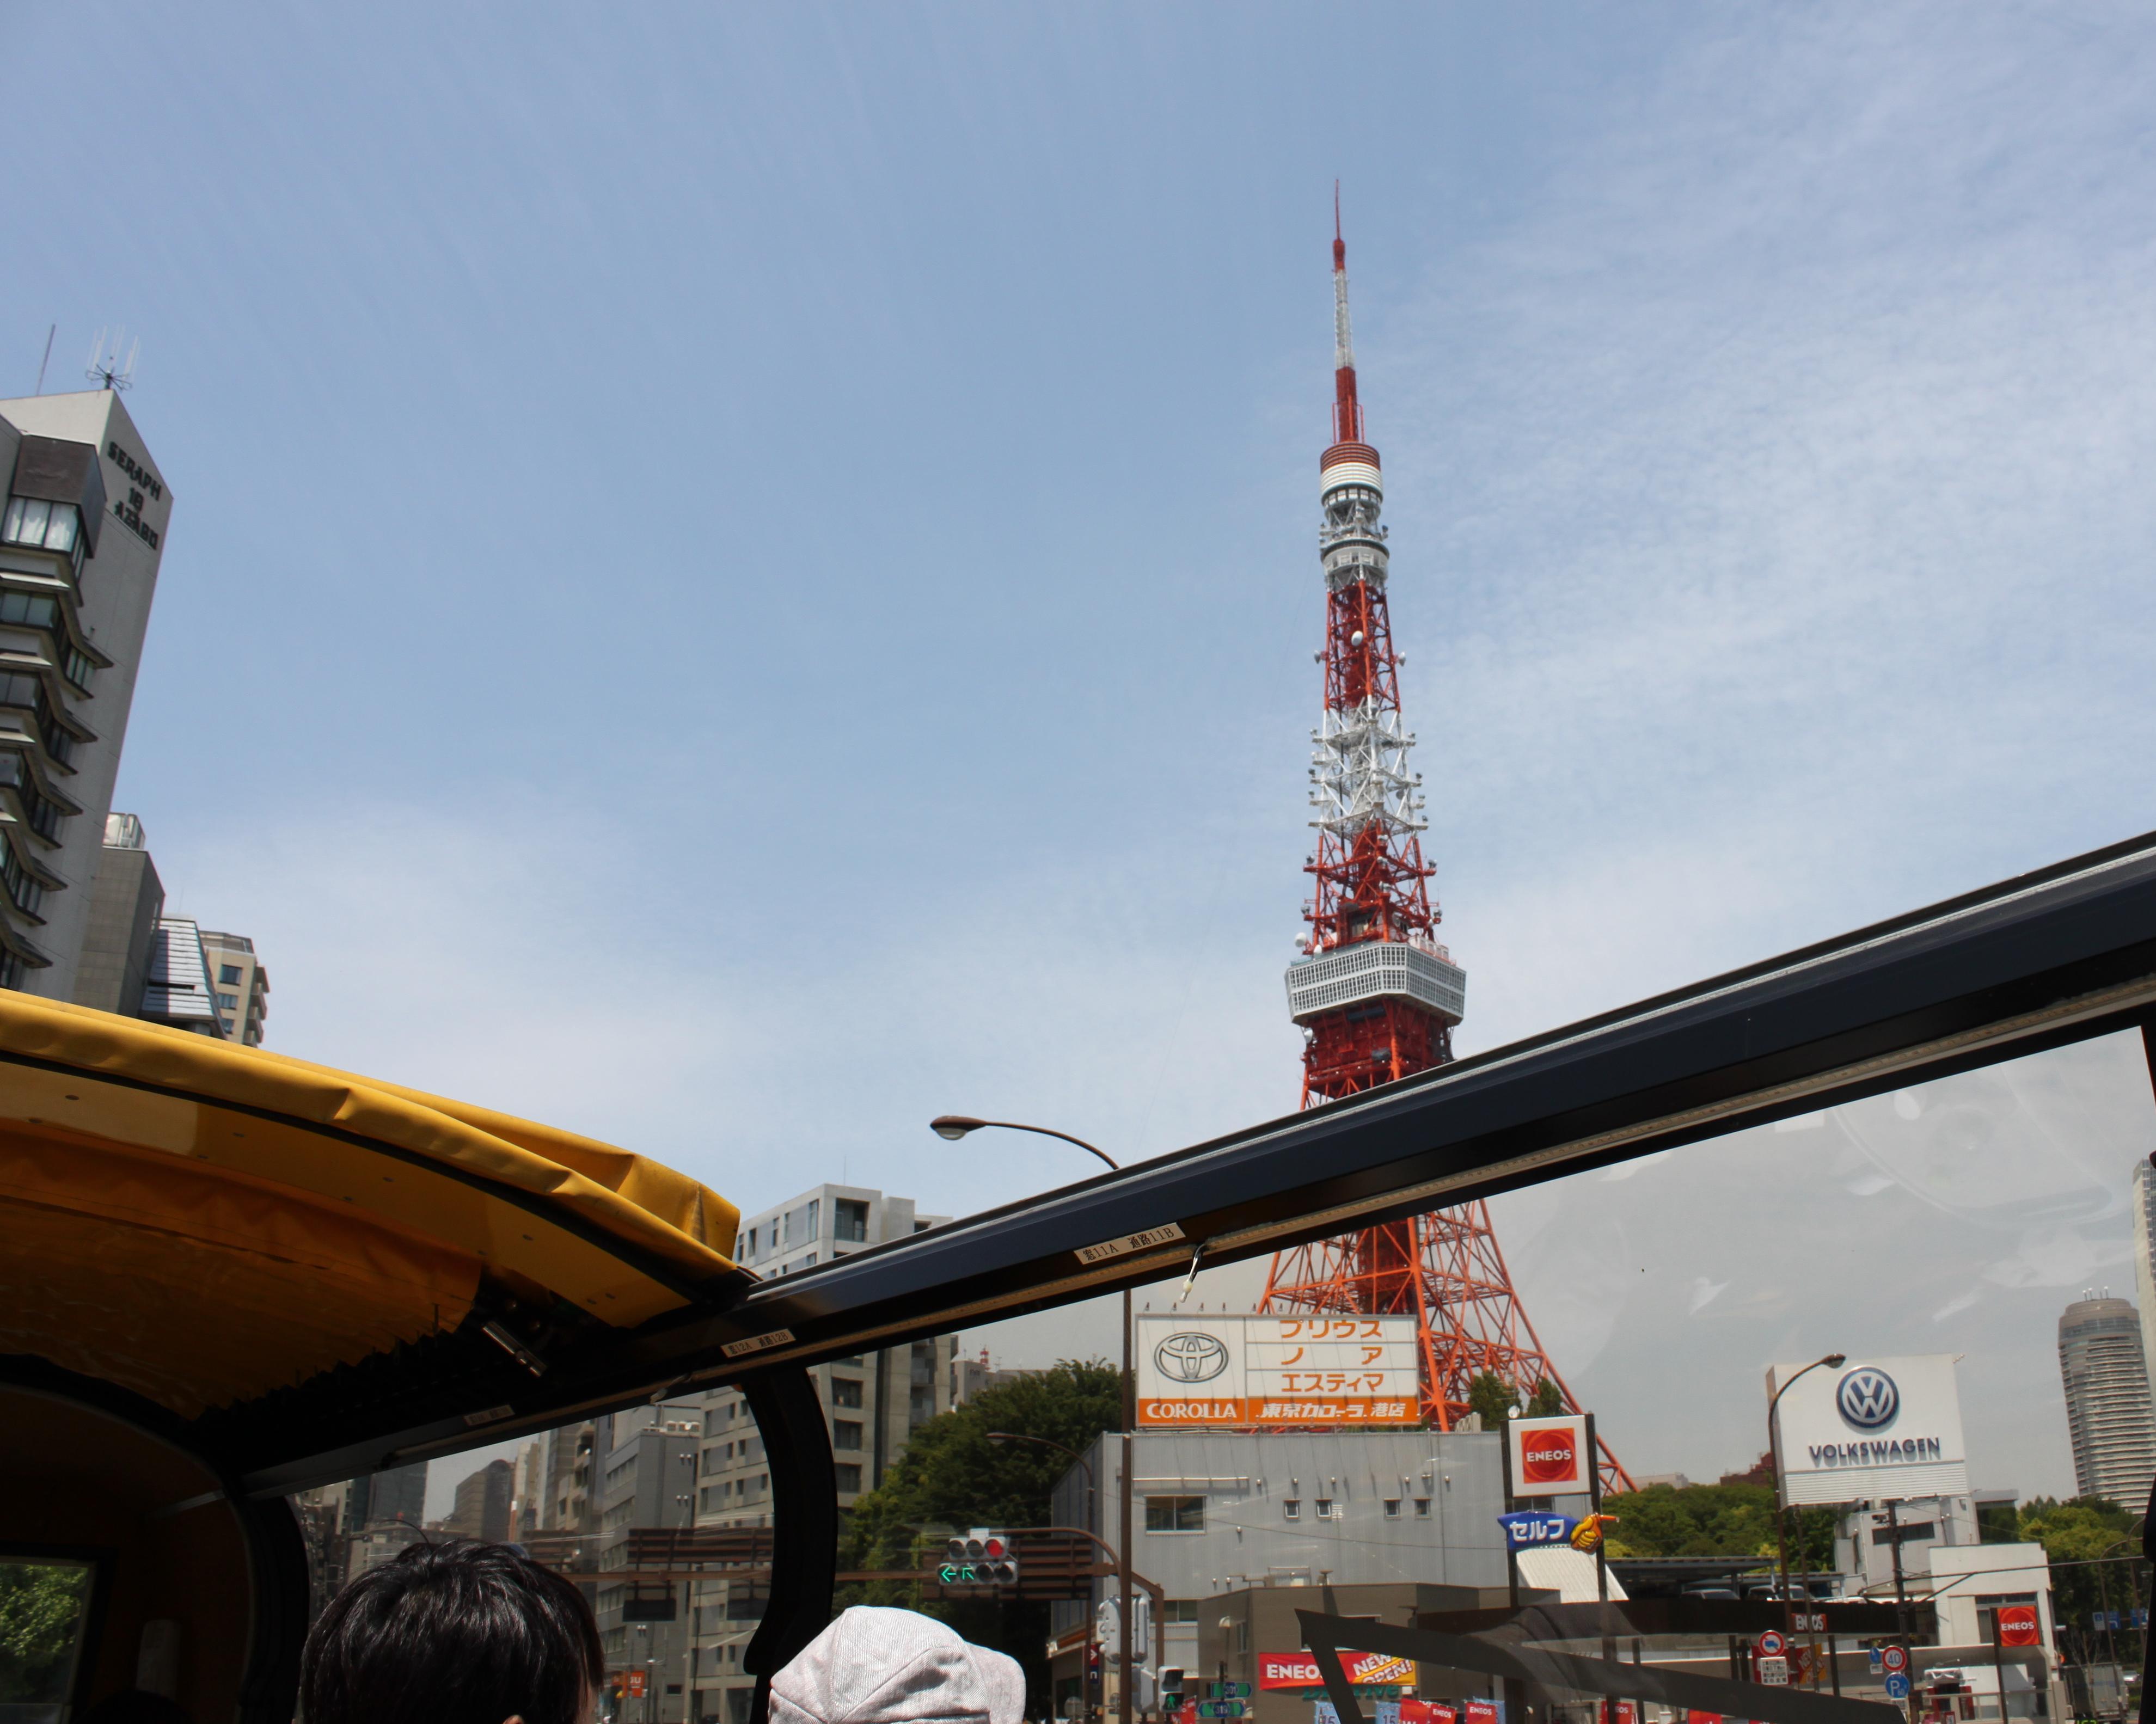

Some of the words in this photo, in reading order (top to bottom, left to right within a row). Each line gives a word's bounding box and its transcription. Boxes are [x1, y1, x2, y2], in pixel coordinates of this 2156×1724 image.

[107, 441, 162, 501] SERAPH
[1082, 1243, 1119, 1261] 窓11A
[1127, 1228, 1174, 1249] 通路11B
[1280, 1320, 1382, 1339] プリウス
[1281, 1373, 1384, 1392] エスティマ
[1147, 1403, 1238, 1418] COROLLA
[1260, 1403, 1364, 1418] 東京カローラ
[1370, 1403, 1406, 1417] 港店
[1526, 1449, 1572, 1462] ENEOS
[1809, 1437, 1941, 1459] VOLKSWAGEN
[1510, 1519, 1564, 1541] セルフ
[1796, 1615, 1823, 1631] ENOS
[2001, 1622, 2035, 1631] ENEOS
[1352, 1654, 1392, 1676] NEW
[1888, 1653, 1902, 1664] 40
[1266, 1664, 1322, 1679] ENEO
[1432, 1708, 1452, 1719] ENEOS
[1469, 1706, 1492, 1716] ENEOS
